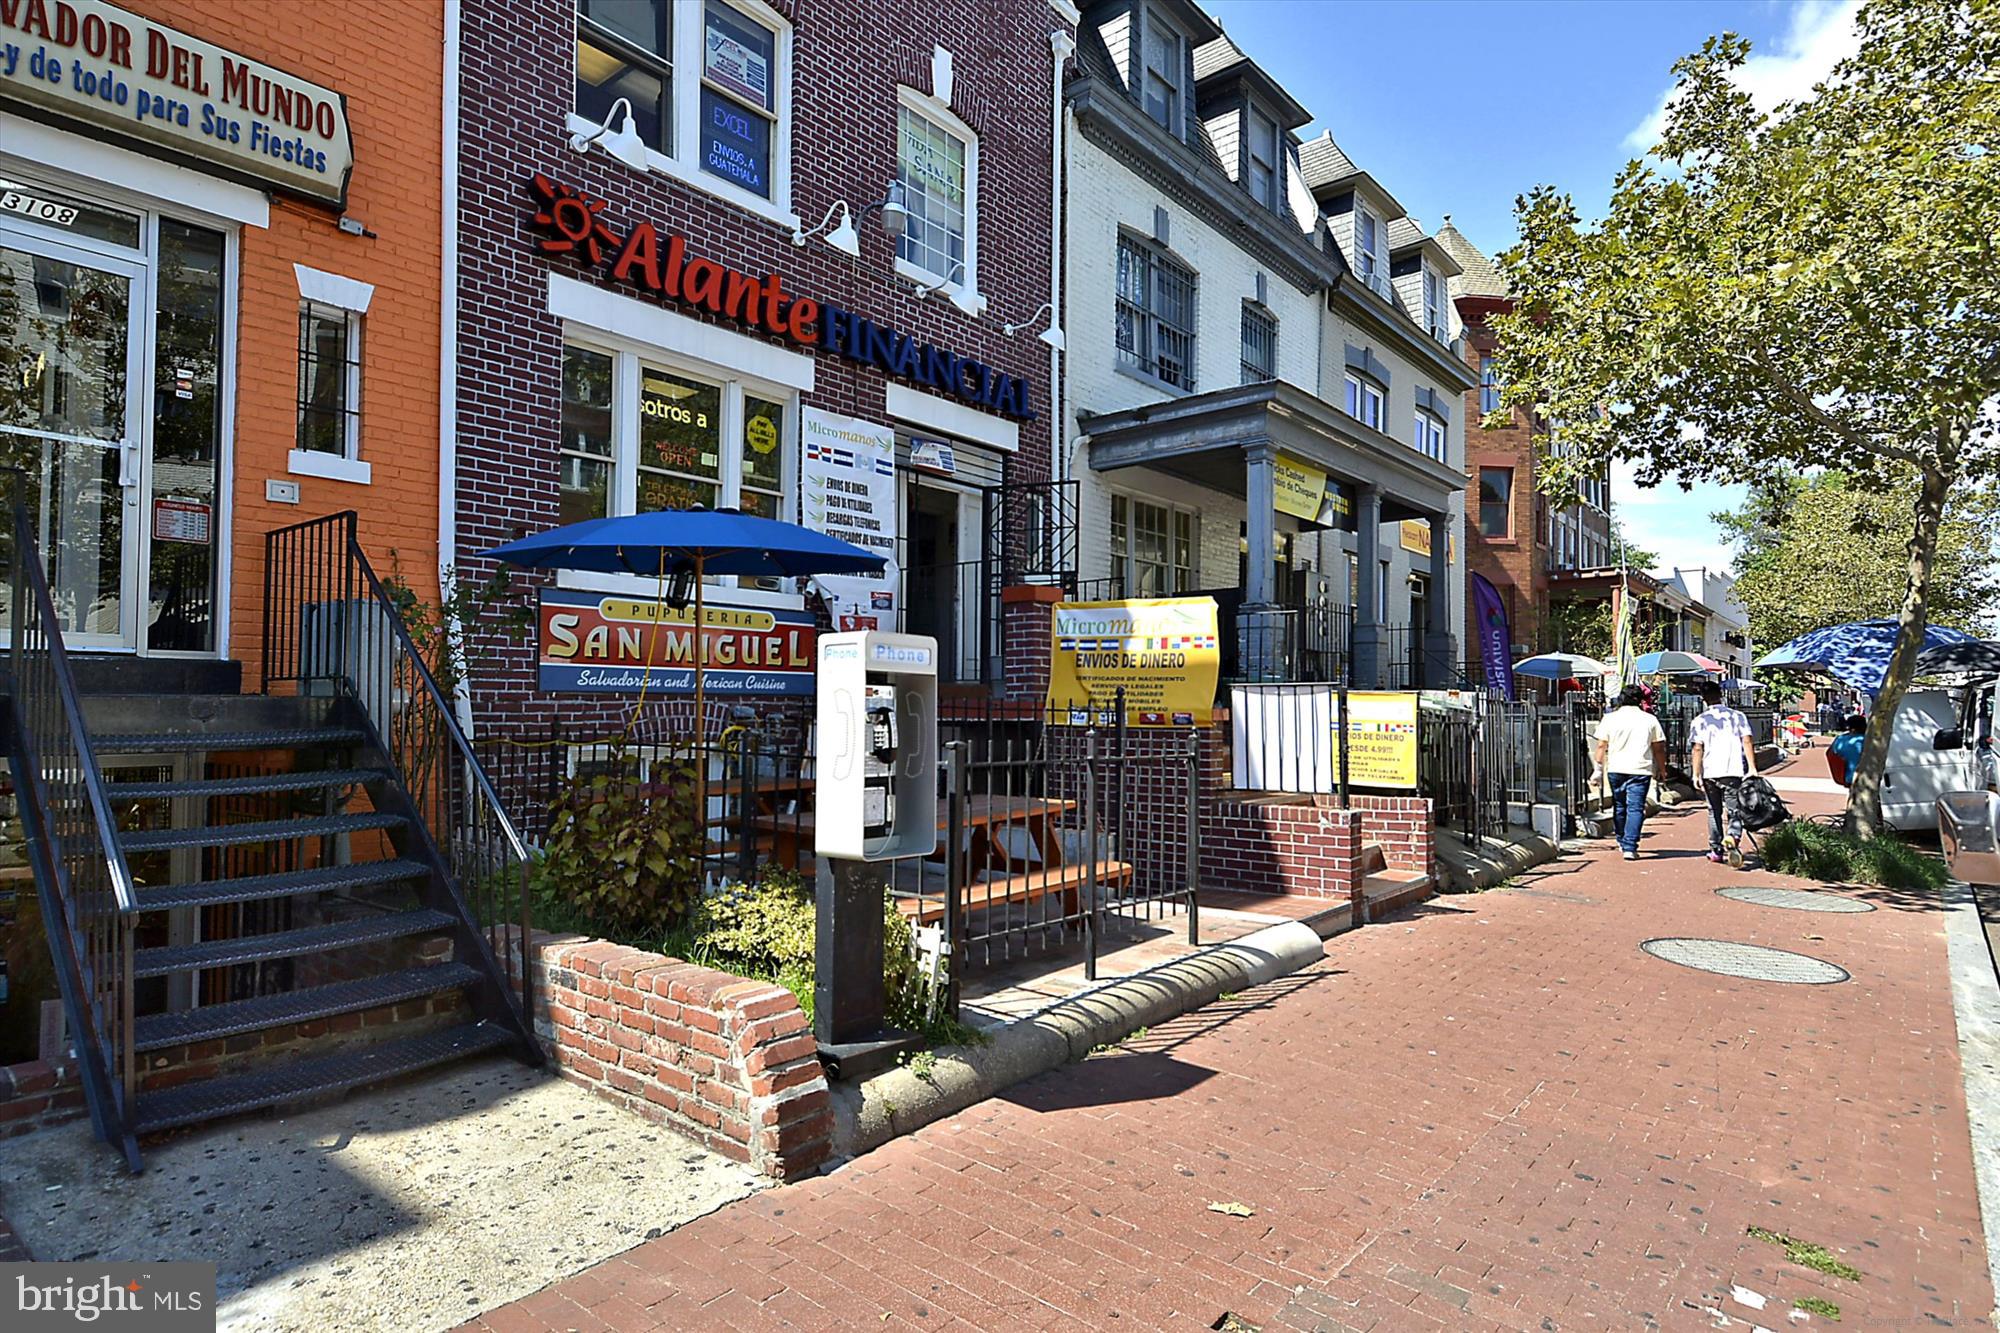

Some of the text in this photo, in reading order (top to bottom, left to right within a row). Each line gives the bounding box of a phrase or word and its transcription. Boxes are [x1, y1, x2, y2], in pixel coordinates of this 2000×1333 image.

[146, 27, 209, 97] DEL
[221, 55, 336, 140] MUNDO
[30, 46, 61, 83] de
[73, 60, 128, 105] todo
[137, 86, 190, 127] para
[201, 103, 241, 144] Sus
[250, 121, 327, 173] Fiestas
[713, 106, 753, 142] EXCEL
[708, 153, 760, 186] GUATEMALA
[4, 194, 76, 223] 3108
[612, 222, 1036, 420] Alante FINANCIAL
[697, 412, 708, 428] a
[807, 420, 877, 447] Micromanos
[660, 451, 692, 467] OPEN
[547, 613, 810, 667] SAN MIGUEL
[876, 644, 926, 663] Phone
[1076, 652, 1186, 669] ENVIOS DE DINERO
[577, 669, 661, 690] Salvadorian
[664, 673, 689, 690] and
[745, 674, 787, 691] Cuisine
[1375, 733, 1405, 742] DINERO
